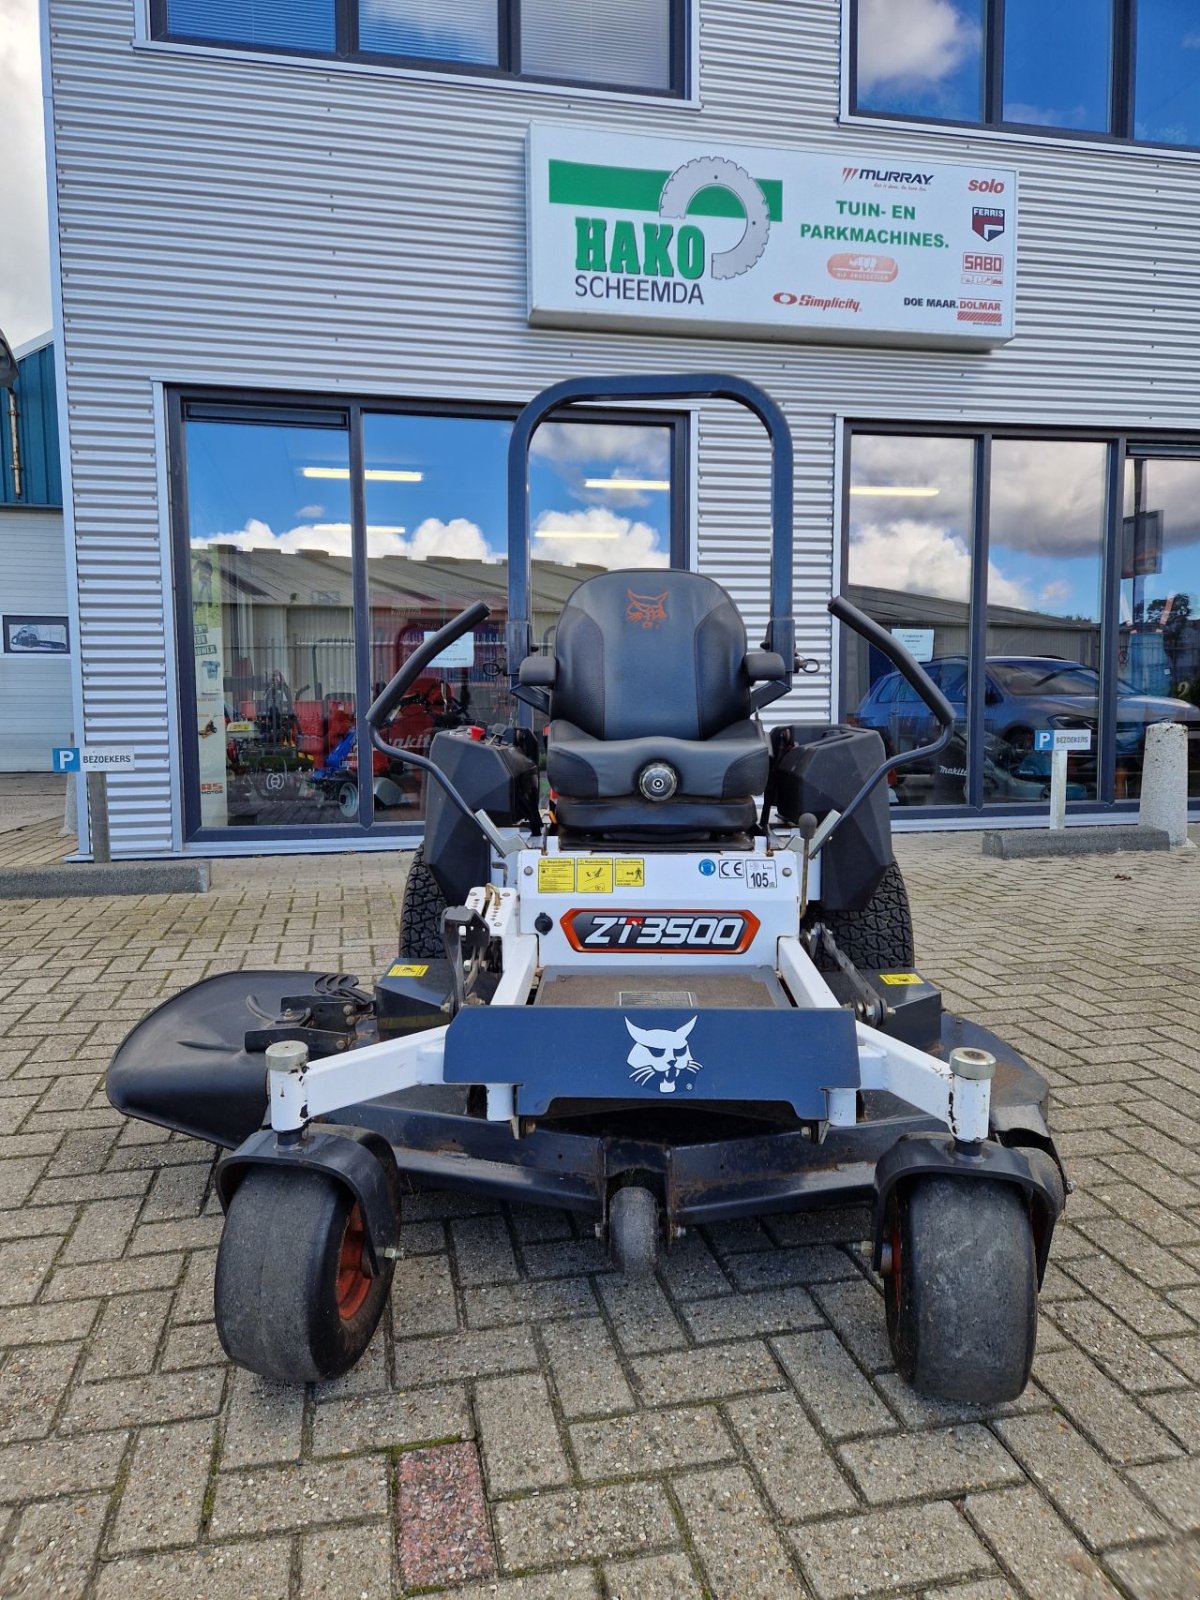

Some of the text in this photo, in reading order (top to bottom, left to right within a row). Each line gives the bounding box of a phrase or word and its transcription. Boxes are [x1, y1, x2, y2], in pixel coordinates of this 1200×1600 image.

[859, 168, 934, 185] MURRAY
[968, 178, 1005, 194] solo
[836, 200, 916, 220] TUIN- EN
[973, 207, 1004, 217] FERRIS
[800, 223, 950, 248] PARKMACHINES.
[575, 216, 706, 280] HAKO
[964, 254, 1003, 272] SABO
[575, 274, 705, 305] SCHEEMDA
[798, 294, 861, 313] Simplicity
[903, 297, 1001, 311] DOE MAAR. DOLMAR
[1039, 732, 1089, 749] P BEZOEKERS
[59, 750, 131, 770] P BEZOEKERS
[720, 861, 743, 877] CE
[750, 872, 769, 888] 105
